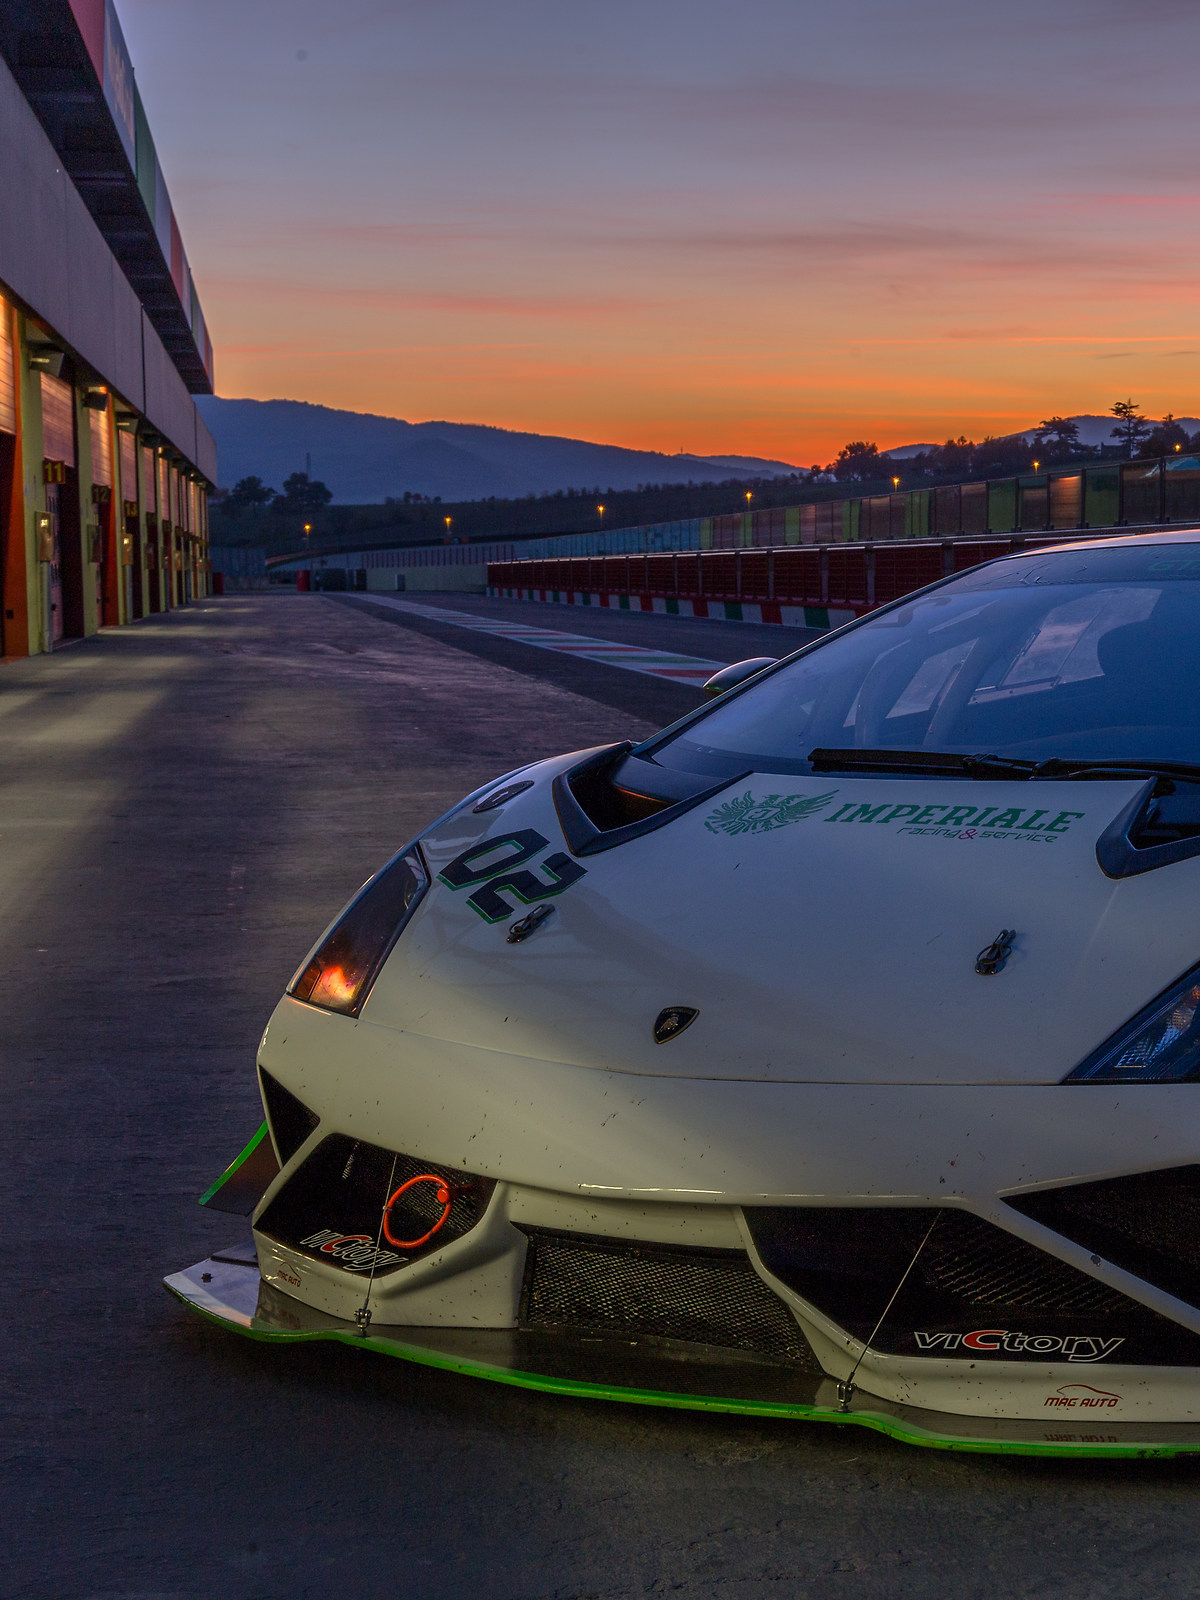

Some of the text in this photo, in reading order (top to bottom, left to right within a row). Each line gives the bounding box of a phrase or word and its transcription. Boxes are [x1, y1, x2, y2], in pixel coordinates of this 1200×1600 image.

[44, 462, 64, 483] 11
[126, 502, 138, 515] 13
[823, 803, 1086, 833] IMPERIALE
[436, 828, 589, 925] 02
[1079, 1398, 1119, 1408] AUTO
